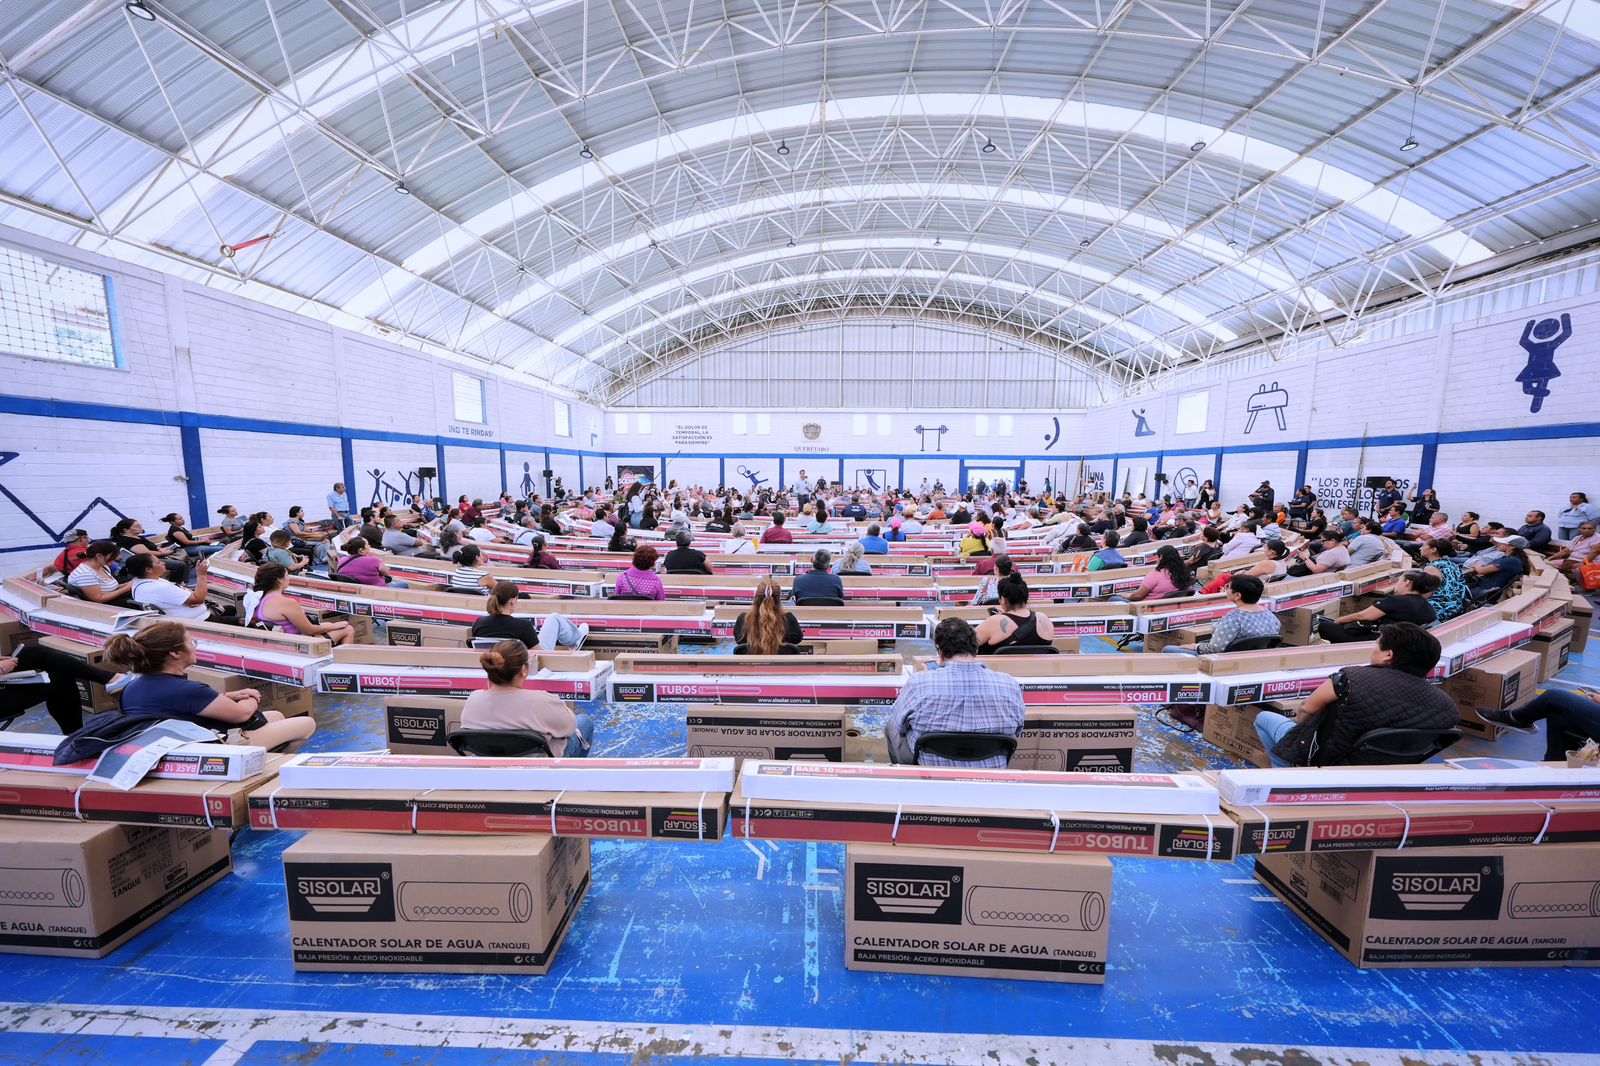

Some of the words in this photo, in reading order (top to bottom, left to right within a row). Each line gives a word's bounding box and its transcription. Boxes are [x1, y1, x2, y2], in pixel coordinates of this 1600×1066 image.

[1318, 488, 1342, 498] SOLO
[1346, 490, 1357, 498] SE
[1316, 500, 1335, 508] CON
[391, 633, 417, 641] SISOLAR
[363, 676, 395, 686] TUBOS
[1267, 681, 1295, 692] TUBOS
[661, 686, 697, 694] TUBOS
[1127, 692, 1163, 701] TUBOS
[394, 718, 438, 729] SISOLAR
[164, 764, 173, 772] 10
[176, 764, 197, 773] BASE
[209, 800, 223, 810] 10
[259, 815, 272, 824] 10
[899, 815, 980, 824] www.sisolar.com.m
[583, 820, 641, 833] TUBOS
[666, 820, 707, 831] SSOLAR
[1318, 823, 1376, 838] TUBOS
[1086, 834, 1148, 850] TUBOS
[112, 878, 141, 899] TANQUE
[298, 881, 374, 895] SISOLAR
[867, 881, 944, 897] SISOLAR
[1391, 877, 1472, 892] SISOLAR
[12, 922, 44, 932] AGUA
[48, 926, 87, 934] (TANQUE)
[292, 937, 377, 948] CALENTADOR
[380, 938, 422, 949] SOLAR
[426, 939, 442, 949] DE
[446, 940, 484, 949] AGUA
[1366, 935, 1441, 945] CALENTADOR
[1443, 936, 1478, 945] SOLAR
[1480, 936, 1496, 944] DE
[1497, 936, 1529, 945] AGUA
[854, 936, 939, 950] CALENTADOR
[943, 941, 986, 952] SOLAR
[989, 943, 1007, 953] DE
[1010, 944, 1048, 955] AGUA
[1053, 949, 1096, 958] (TANQUE)
[318, 953, 350, 961] PRESIÓN:
[878, 952, 912, 962] PRESIÓN:
[940, 957, 985, 966] INOXIDABLE
